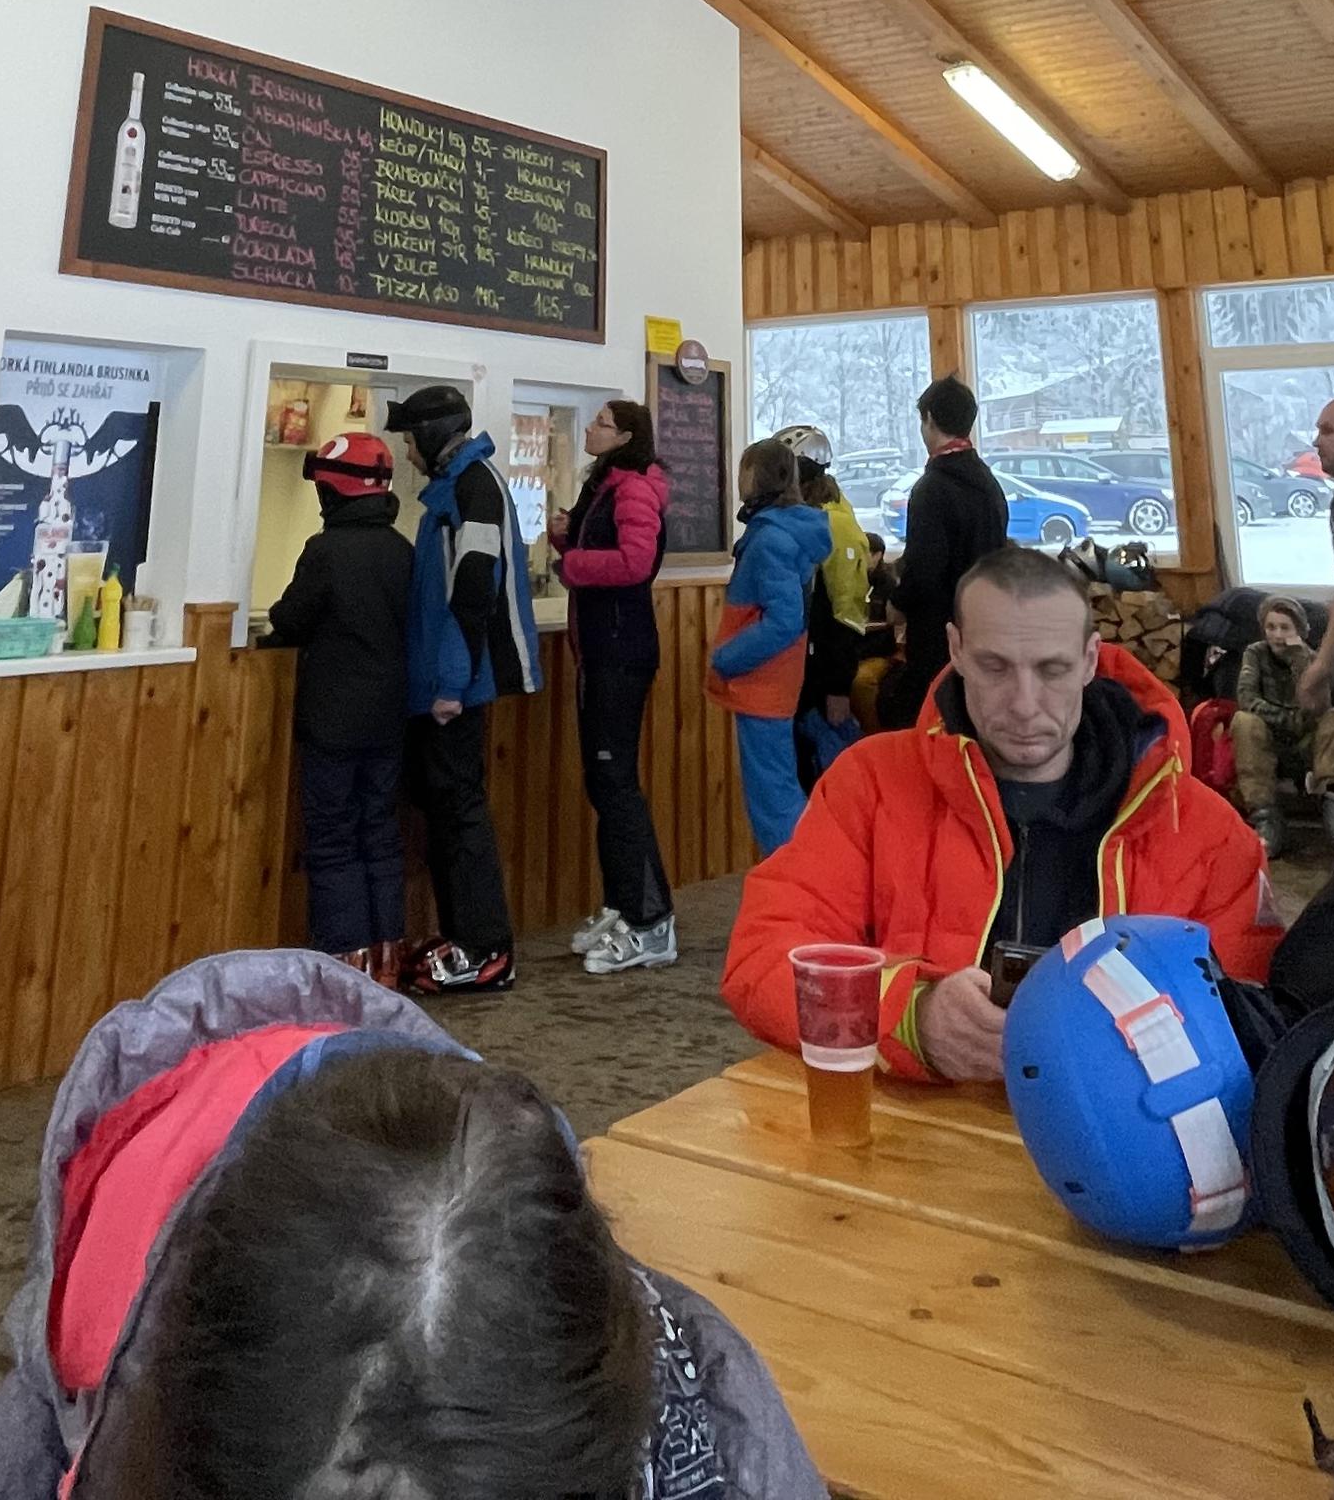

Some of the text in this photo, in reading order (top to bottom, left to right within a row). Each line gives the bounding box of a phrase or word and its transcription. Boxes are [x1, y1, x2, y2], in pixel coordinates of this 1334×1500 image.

[379, 106, 444, 150] HRANOLKY
[236, 188, 289, 214] LATTE
[377, 252, 389, 270] V
[369, 272, 430, 303] PIZZA
[0, 355, 150, 383] ORKÁ FINLANDIA BRUSINKA
[57, 381, 70, 398] SE
